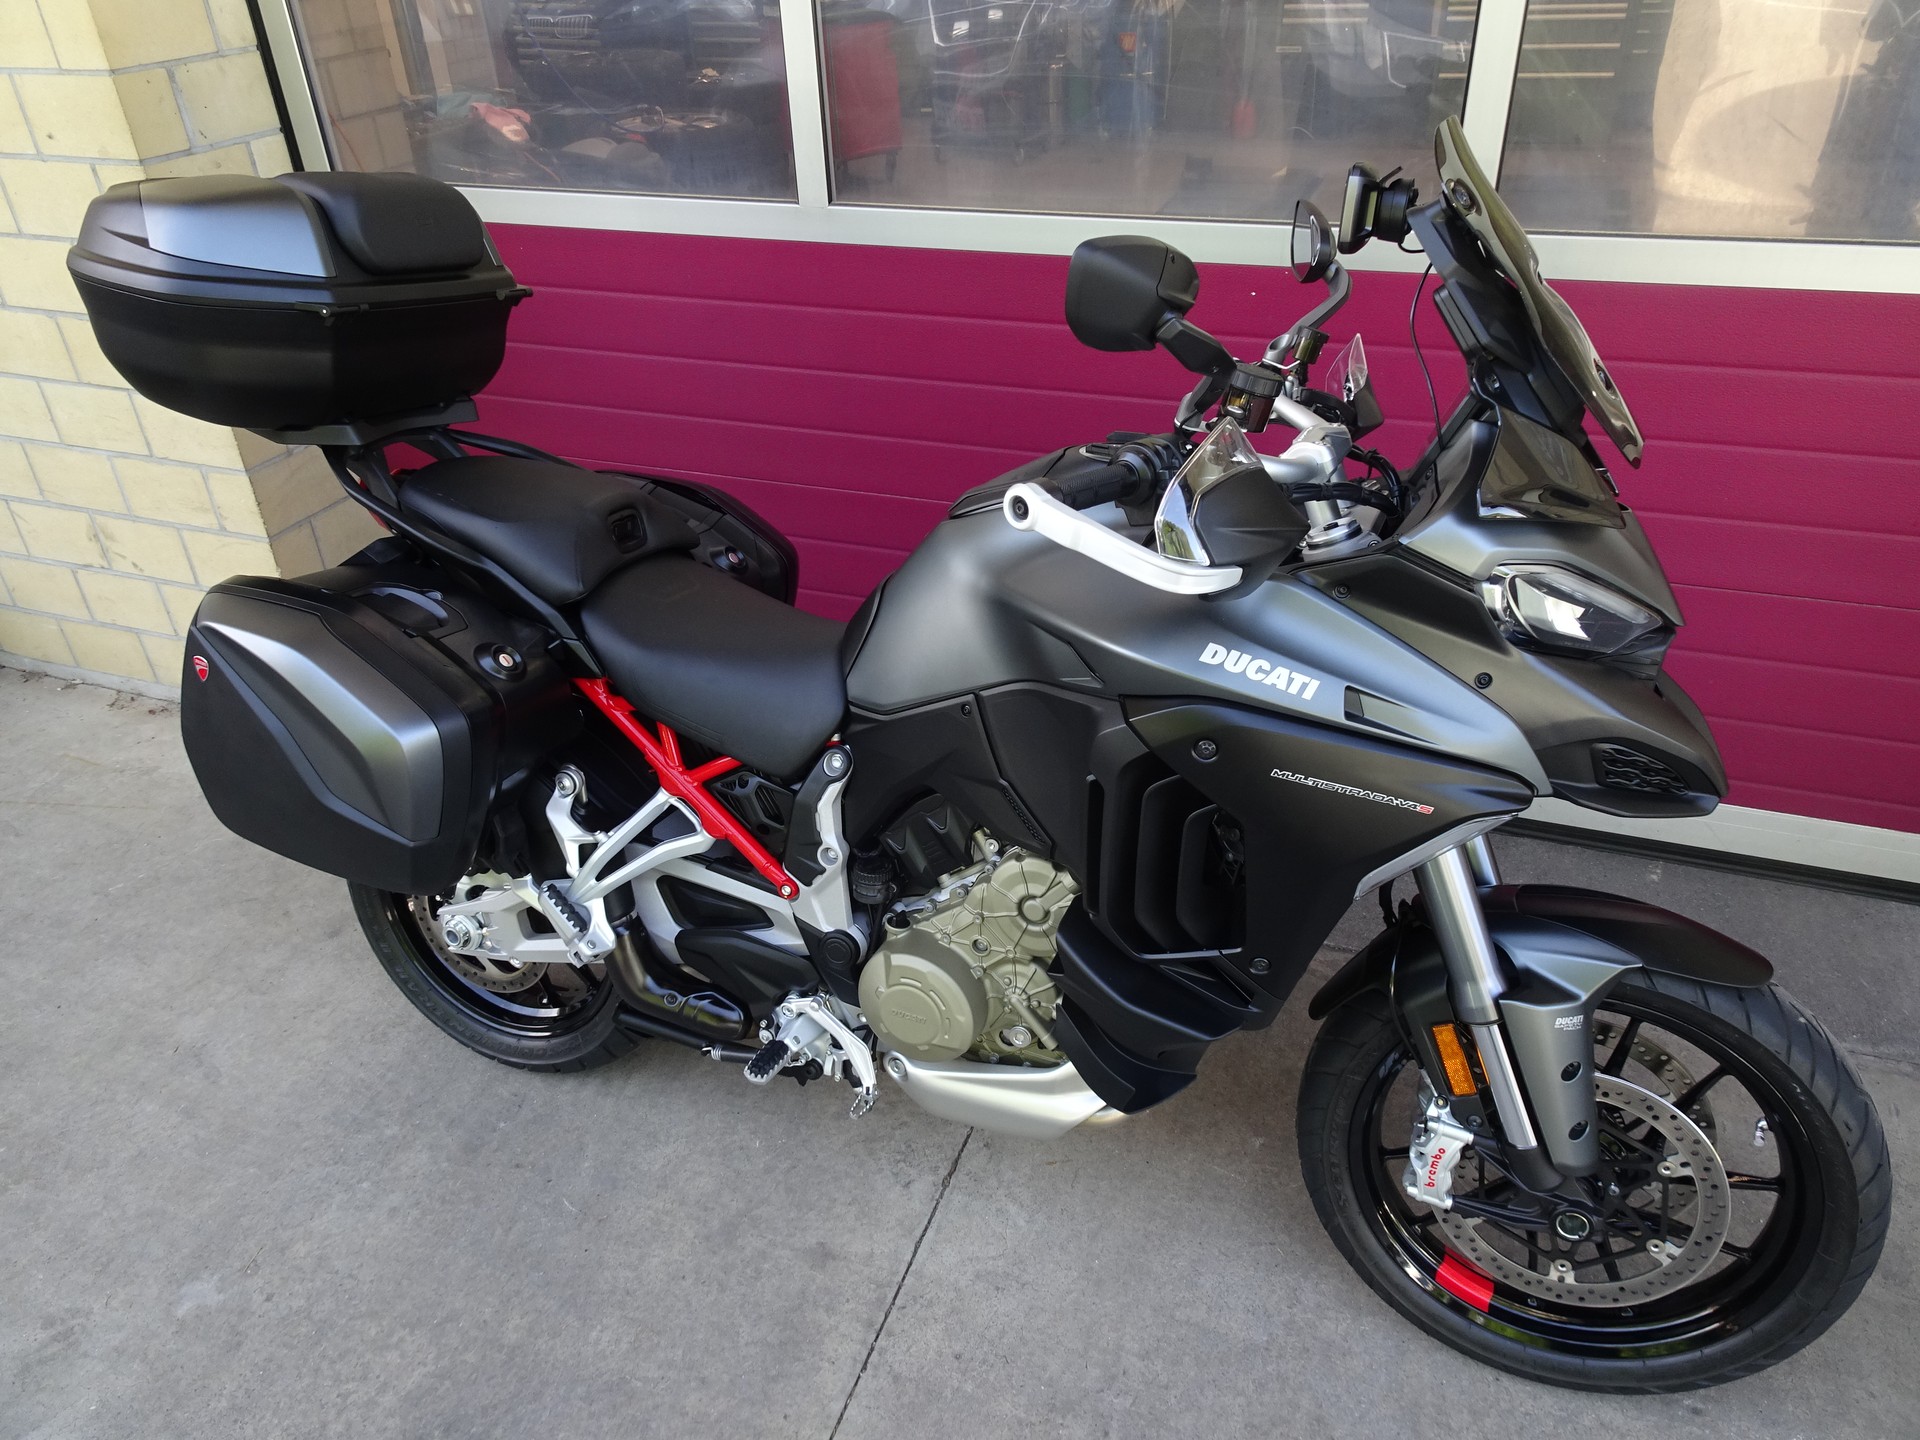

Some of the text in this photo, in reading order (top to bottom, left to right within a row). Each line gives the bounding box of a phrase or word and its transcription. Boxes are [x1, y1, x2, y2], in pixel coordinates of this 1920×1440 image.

[1199, 642, 1320, 700] DUCATI
[1554, 1015, 1584, 1025] DUCATI
[1424, 1147, 1446, 1188] brembo
